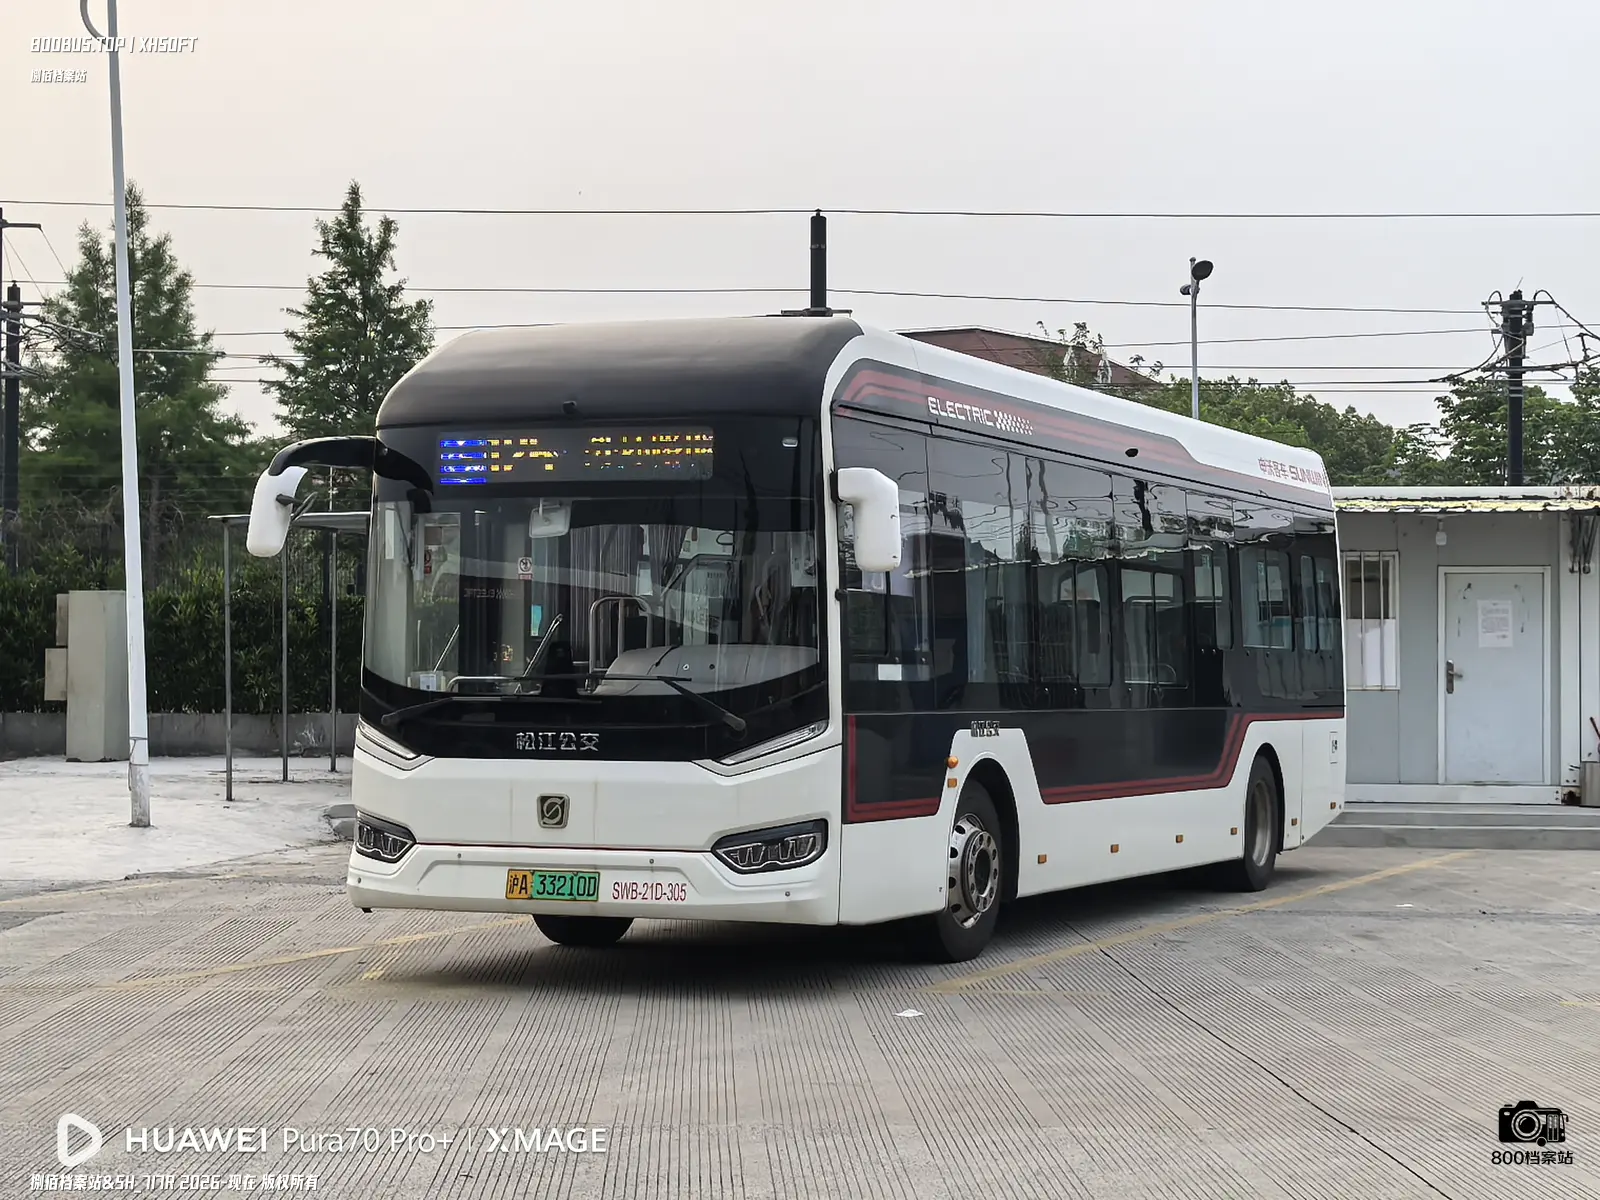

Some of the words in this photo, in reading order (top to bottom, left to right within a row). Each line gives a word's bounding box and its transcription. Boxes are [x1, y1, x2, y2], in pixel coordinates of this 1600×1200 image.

[927, 396, 995, 427] ELECTRIC
[515, 732, 600, 752] 松江公交
[508, 874, 529, 895] 沪A
[536, 874, 597, 897] 33210D
[612, 881, 687, 902] SWB-21D-305
